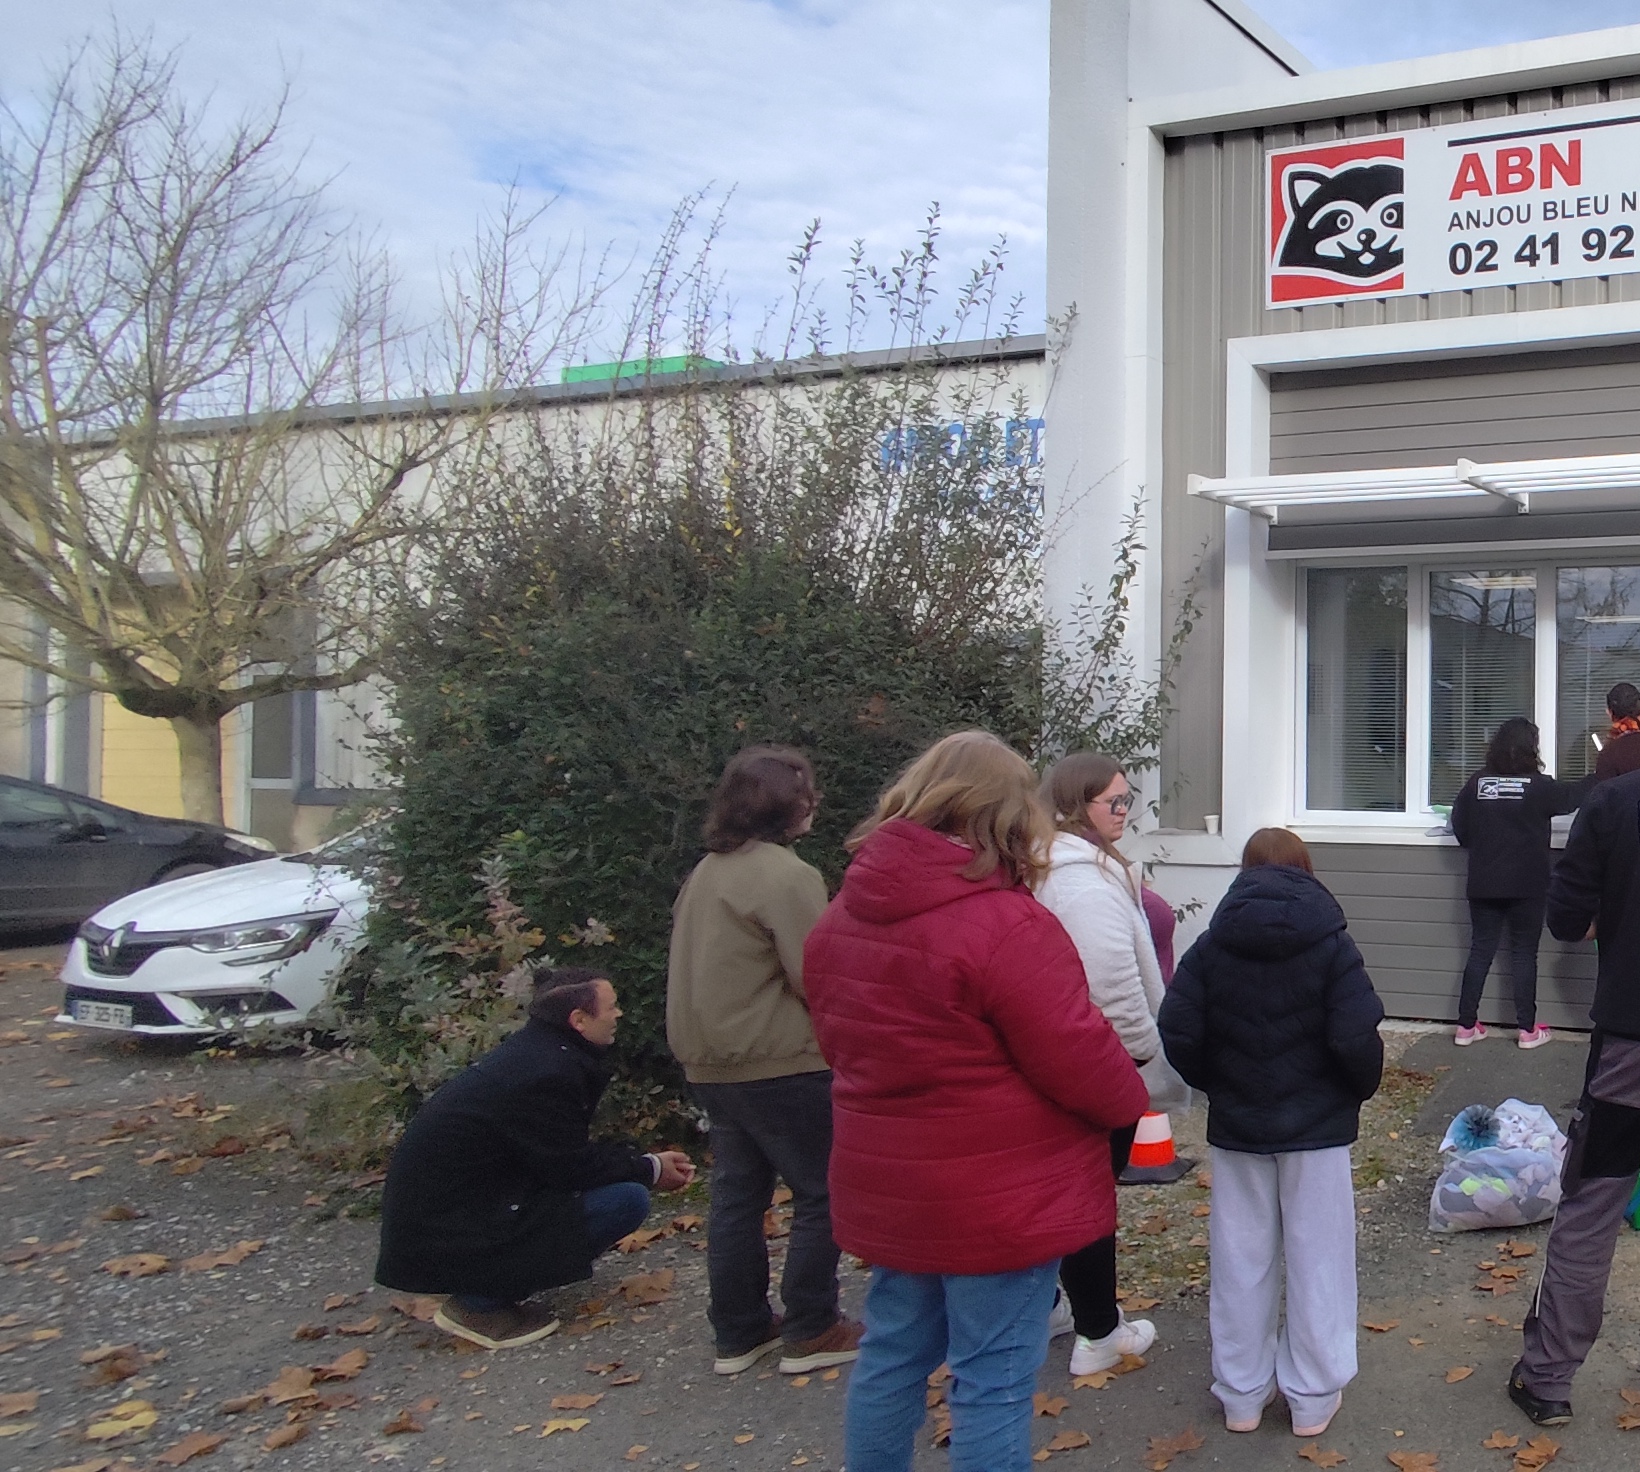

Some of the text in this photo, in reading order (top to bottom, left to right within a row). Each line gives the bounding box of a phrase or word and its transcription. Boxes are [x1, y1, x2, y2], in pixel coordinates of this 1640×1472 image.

[1448, 138, 1582, 200] ABN
[1447, 204, 1532, 232] ANJOU
[1542, 196, 1609, 222] BLEU
[1448, 240, 1499, 276] 02
[1514, 232, 1560, 268] 41
[1581, 225, 1635, 262] 92
